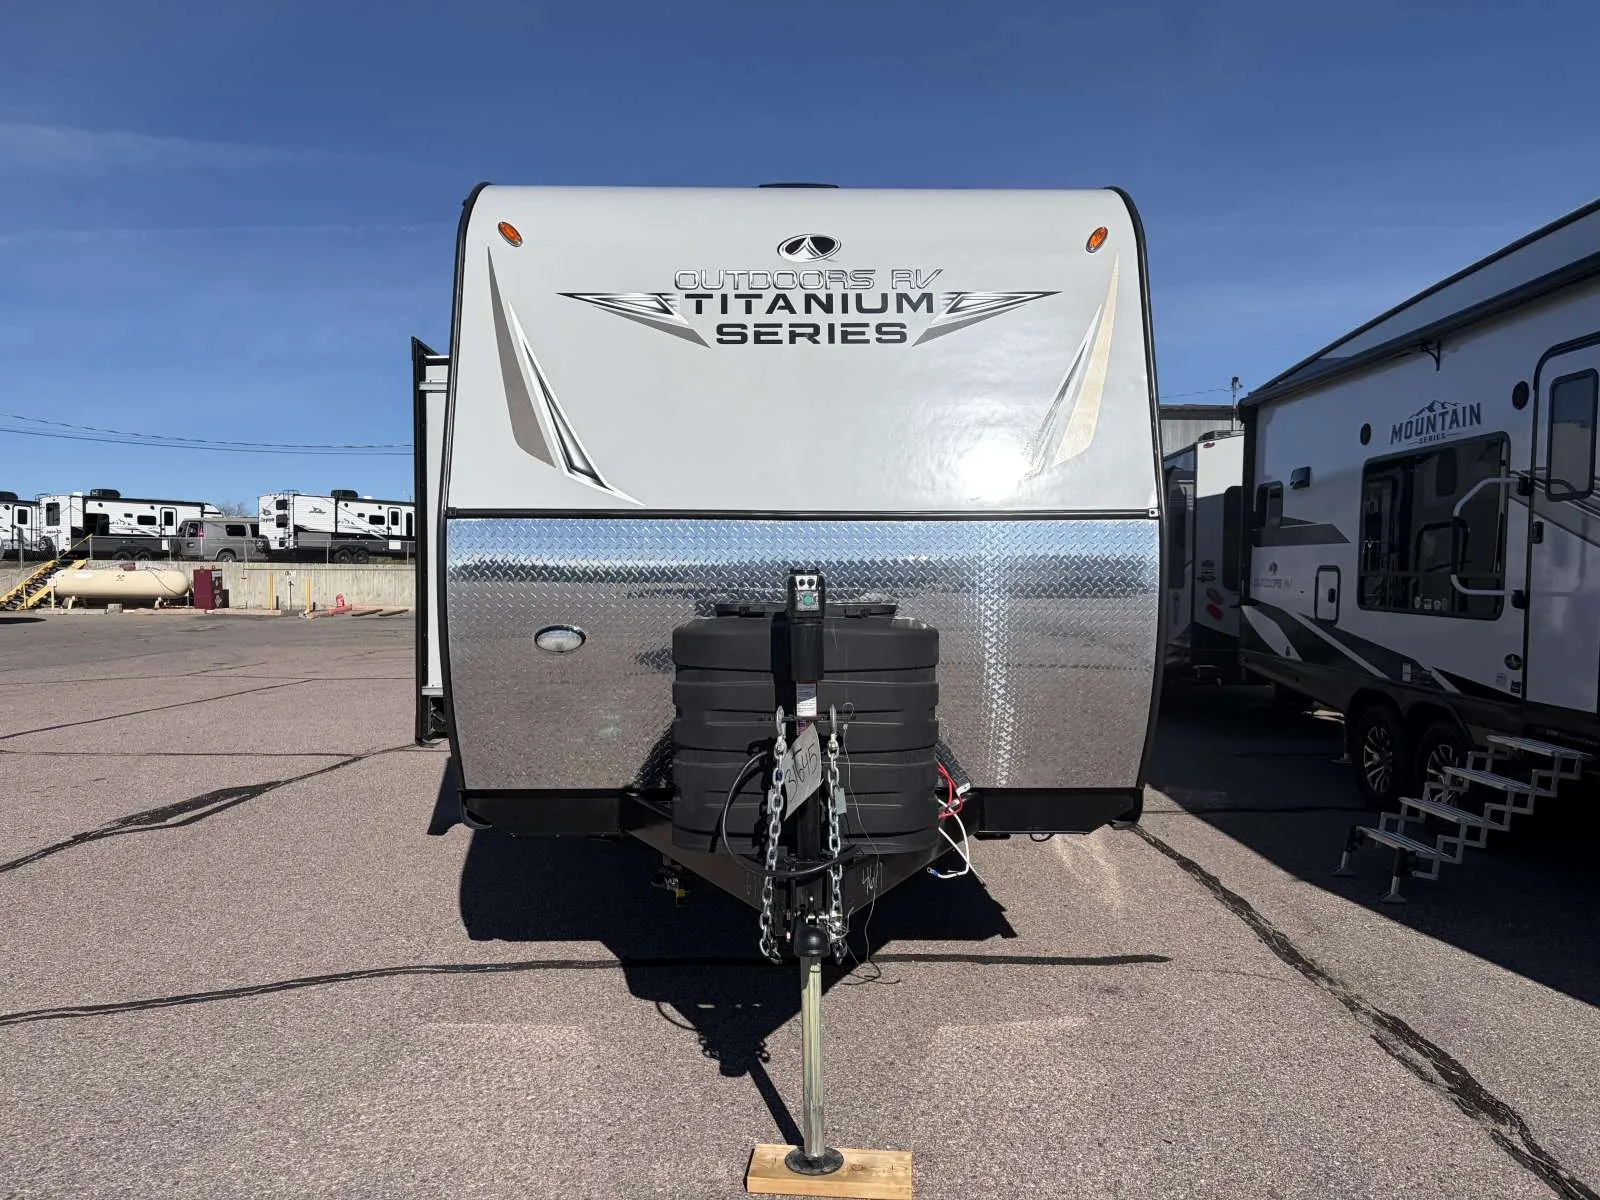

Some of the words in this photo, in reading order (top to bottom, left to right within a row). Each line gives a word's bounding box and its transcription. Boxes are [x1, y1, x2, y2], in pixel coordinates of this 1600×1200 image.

[674, 269, 876, 290] OUTDOORS
[891, 269, 944, 290] RV
[685, 293, 934, 314] TITANIUM
[716, 323, 908, 345] SERIES
[1390, 402, 1482, 445] MOUNTAIN
[1418, 433, 1446, 444] SERIES
